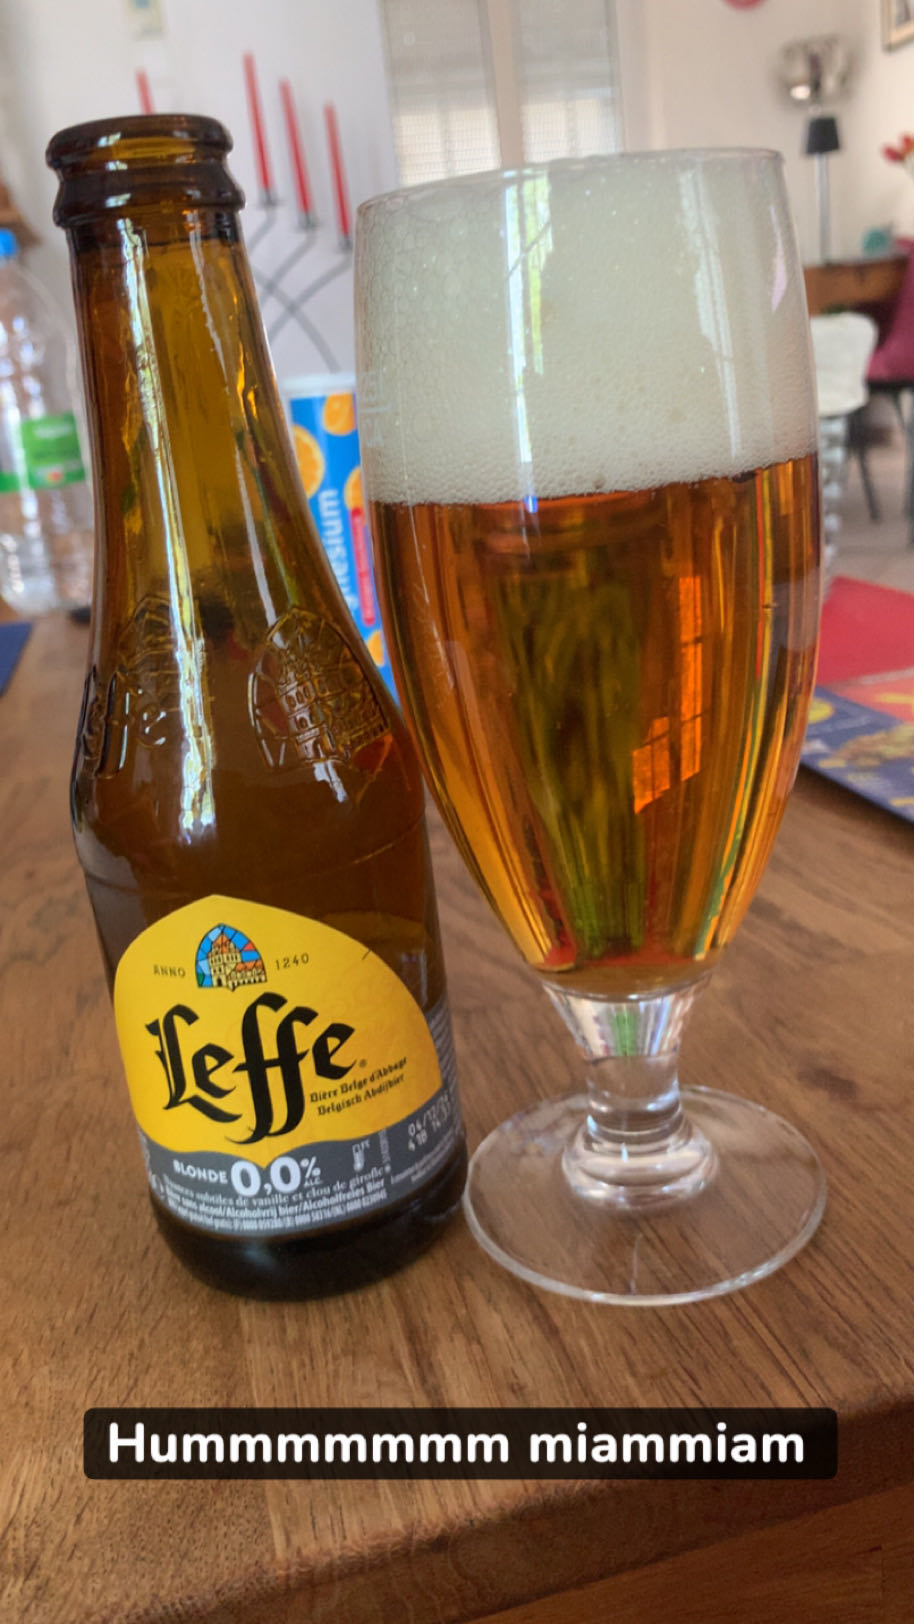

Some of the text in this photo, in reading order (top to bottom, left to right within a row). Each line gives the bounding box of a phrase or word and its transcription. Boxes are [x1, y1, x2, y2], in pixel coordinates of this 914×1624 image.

[153, 964, 186, 979] ANNO
[275, 953, 309, 971] 1240
[145, 992, 357, 1144] Leffe
[172, 1159, 228, 1185] BLONDE
